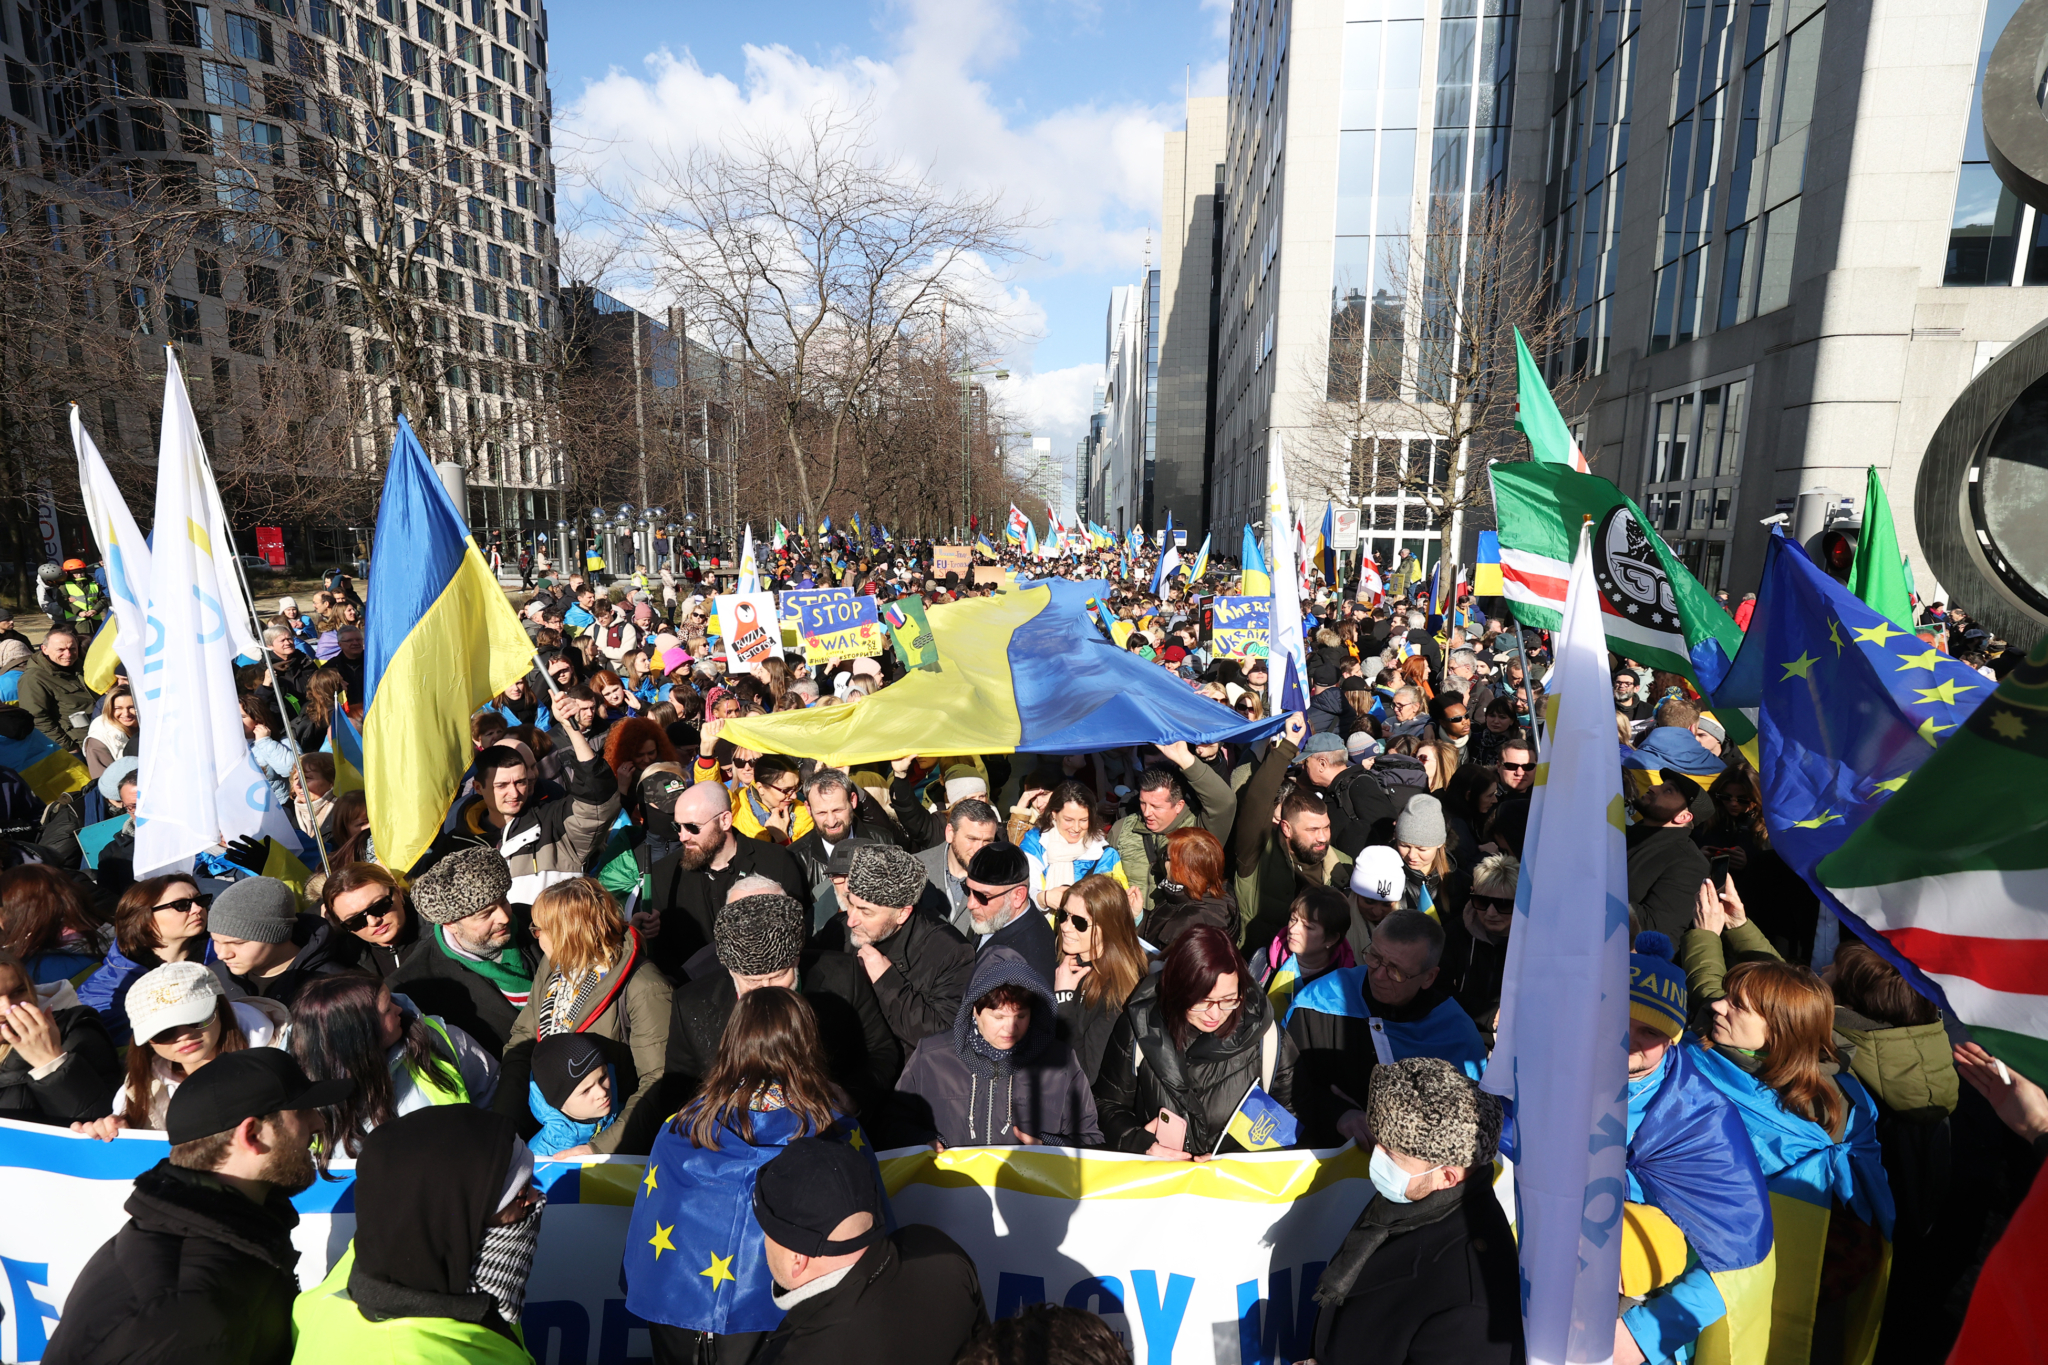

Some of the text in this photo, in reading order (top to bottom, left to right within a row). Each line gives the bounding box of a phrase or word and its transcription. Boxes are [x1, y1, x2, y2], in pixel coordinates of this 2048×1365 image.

[812, 601, 863, 627] STOP
[1214, 598, 1270, 624] KhERS
[1247, 620, 1257, 629] IS
[820, 633, 859, 651] WAR
